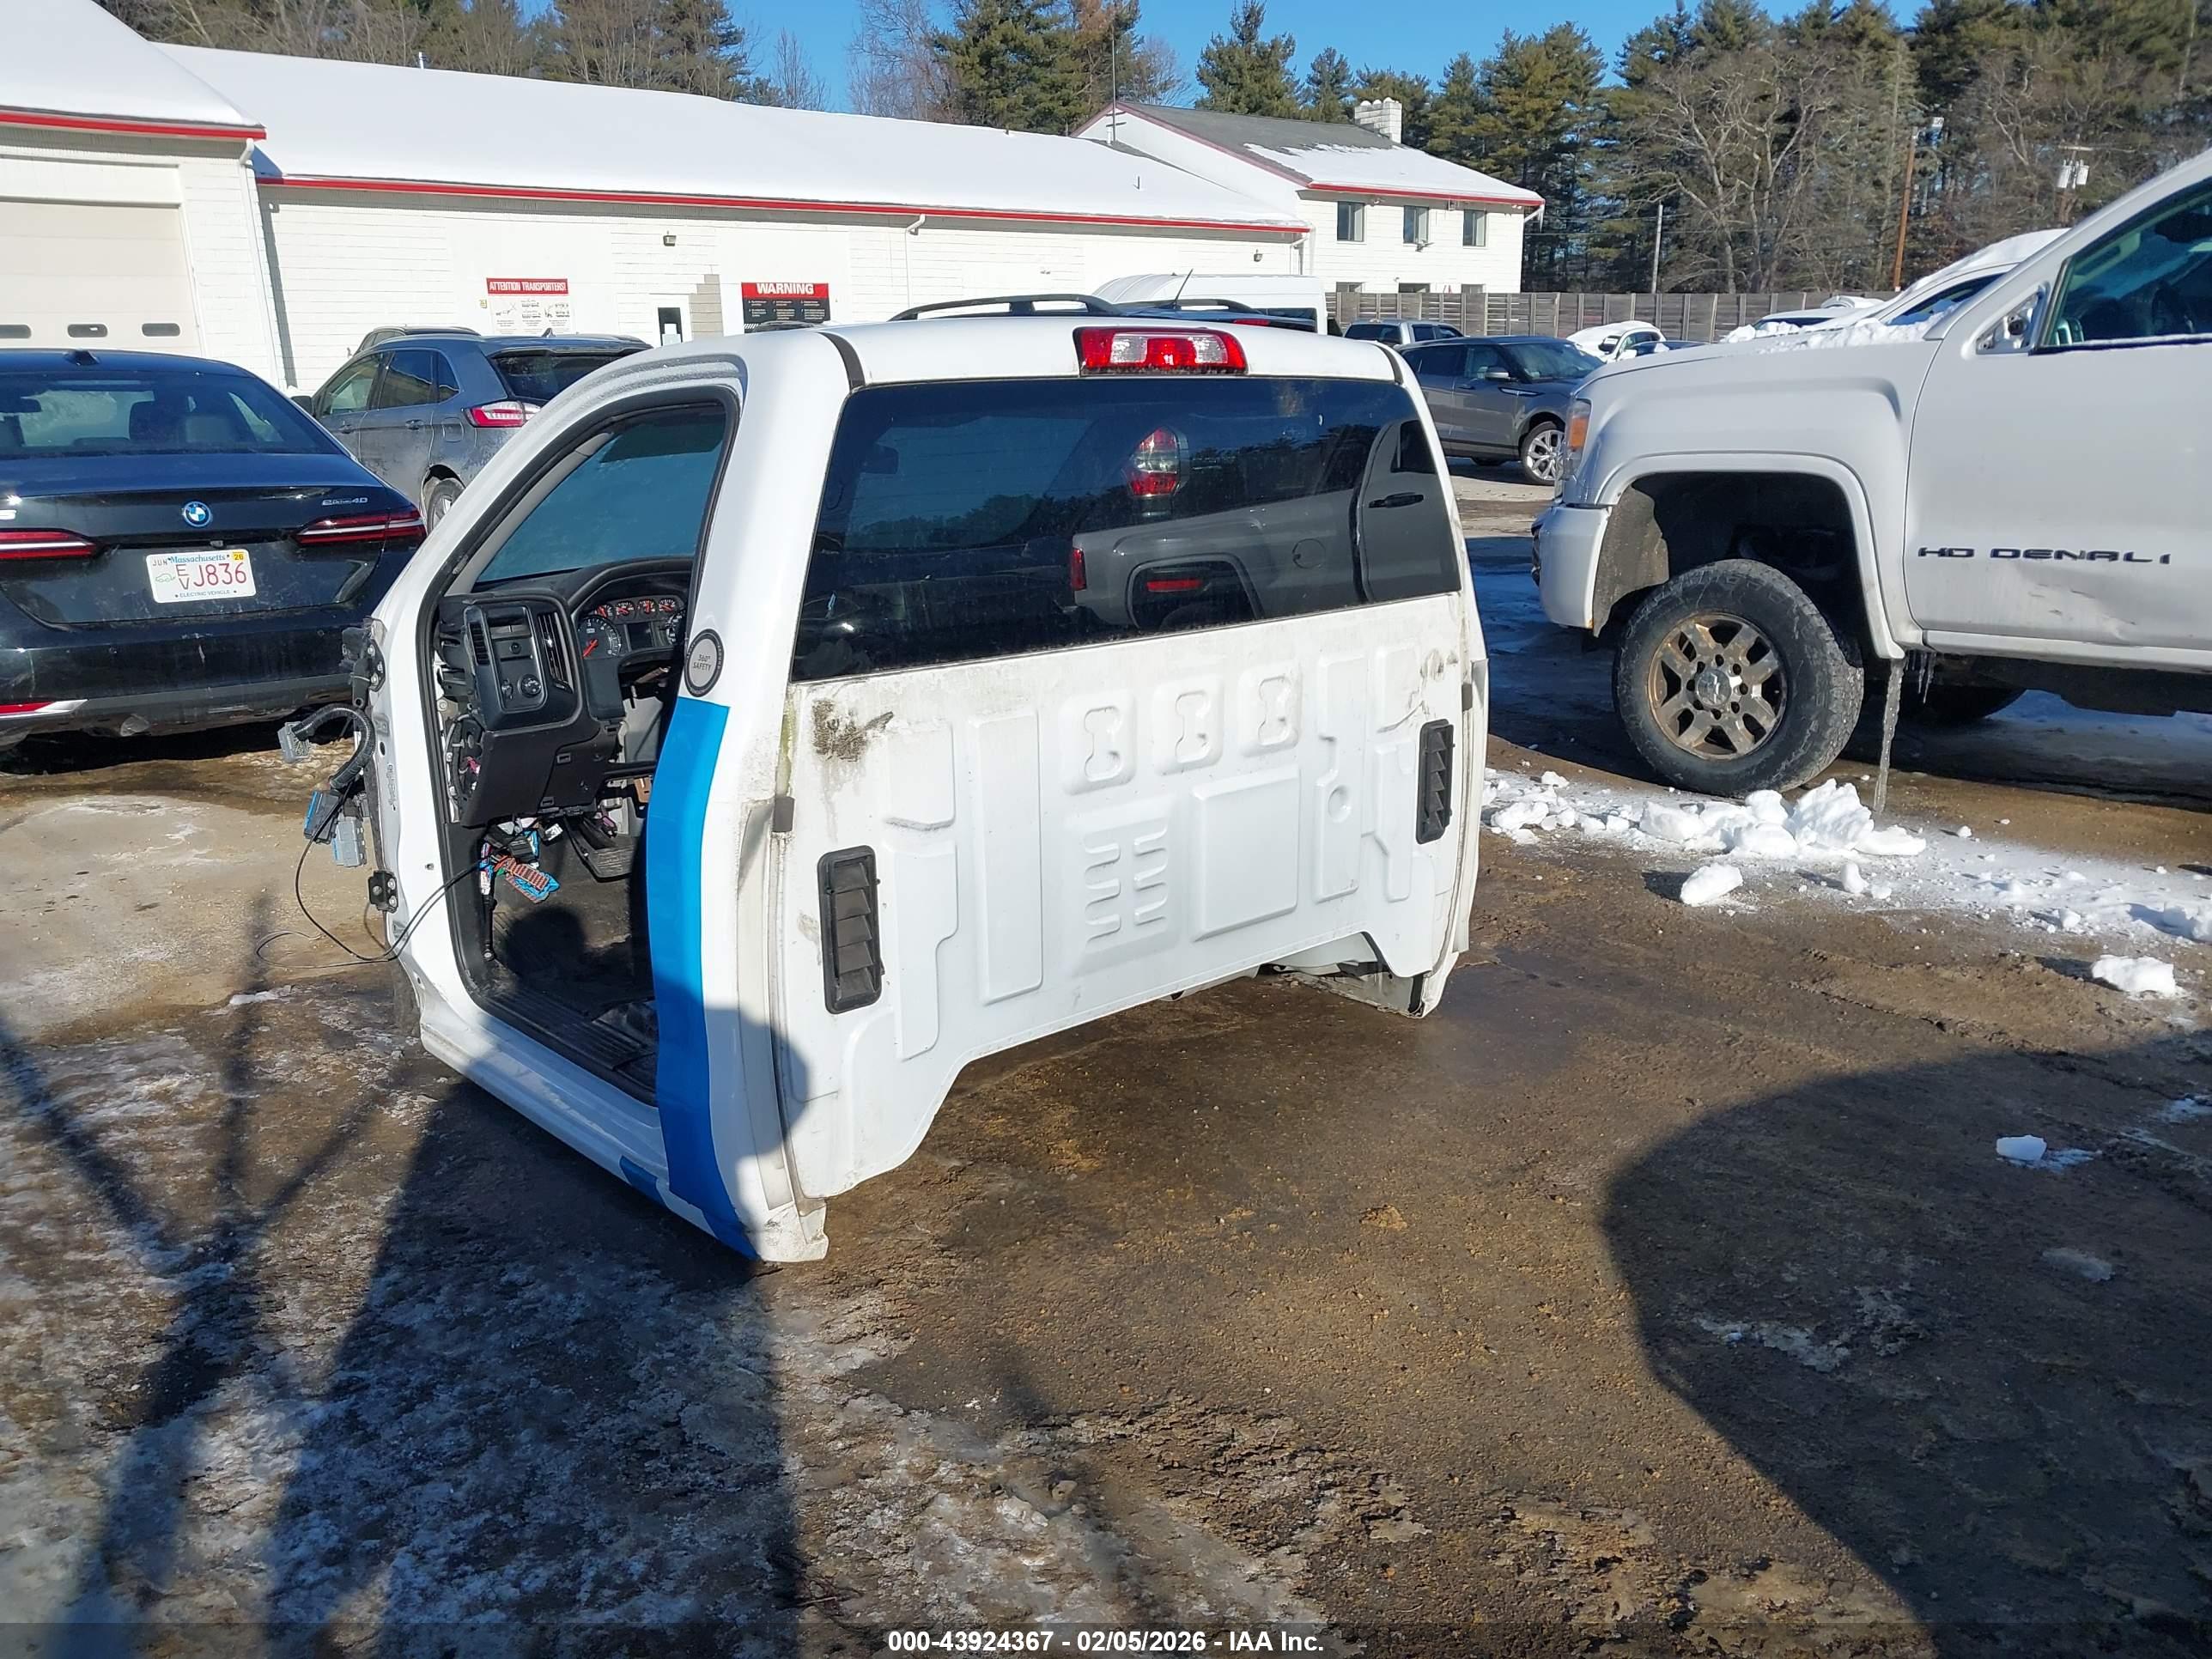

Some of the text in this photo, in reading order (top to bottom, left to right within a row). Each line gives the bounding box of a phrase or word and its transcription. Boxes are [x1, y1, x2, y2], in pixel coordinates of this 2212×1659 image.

[489, 282, 566, 291] ATTENTION TRANSPORTERS!
[756, 283, 814, 295] WARNING
[171, 554, 226, 563] Massachusetts
[1917, 547, 2172, 565] HD DENALI
[193, 562, 246, 587] J836
[693, 662, 712, 672] SAFETY
